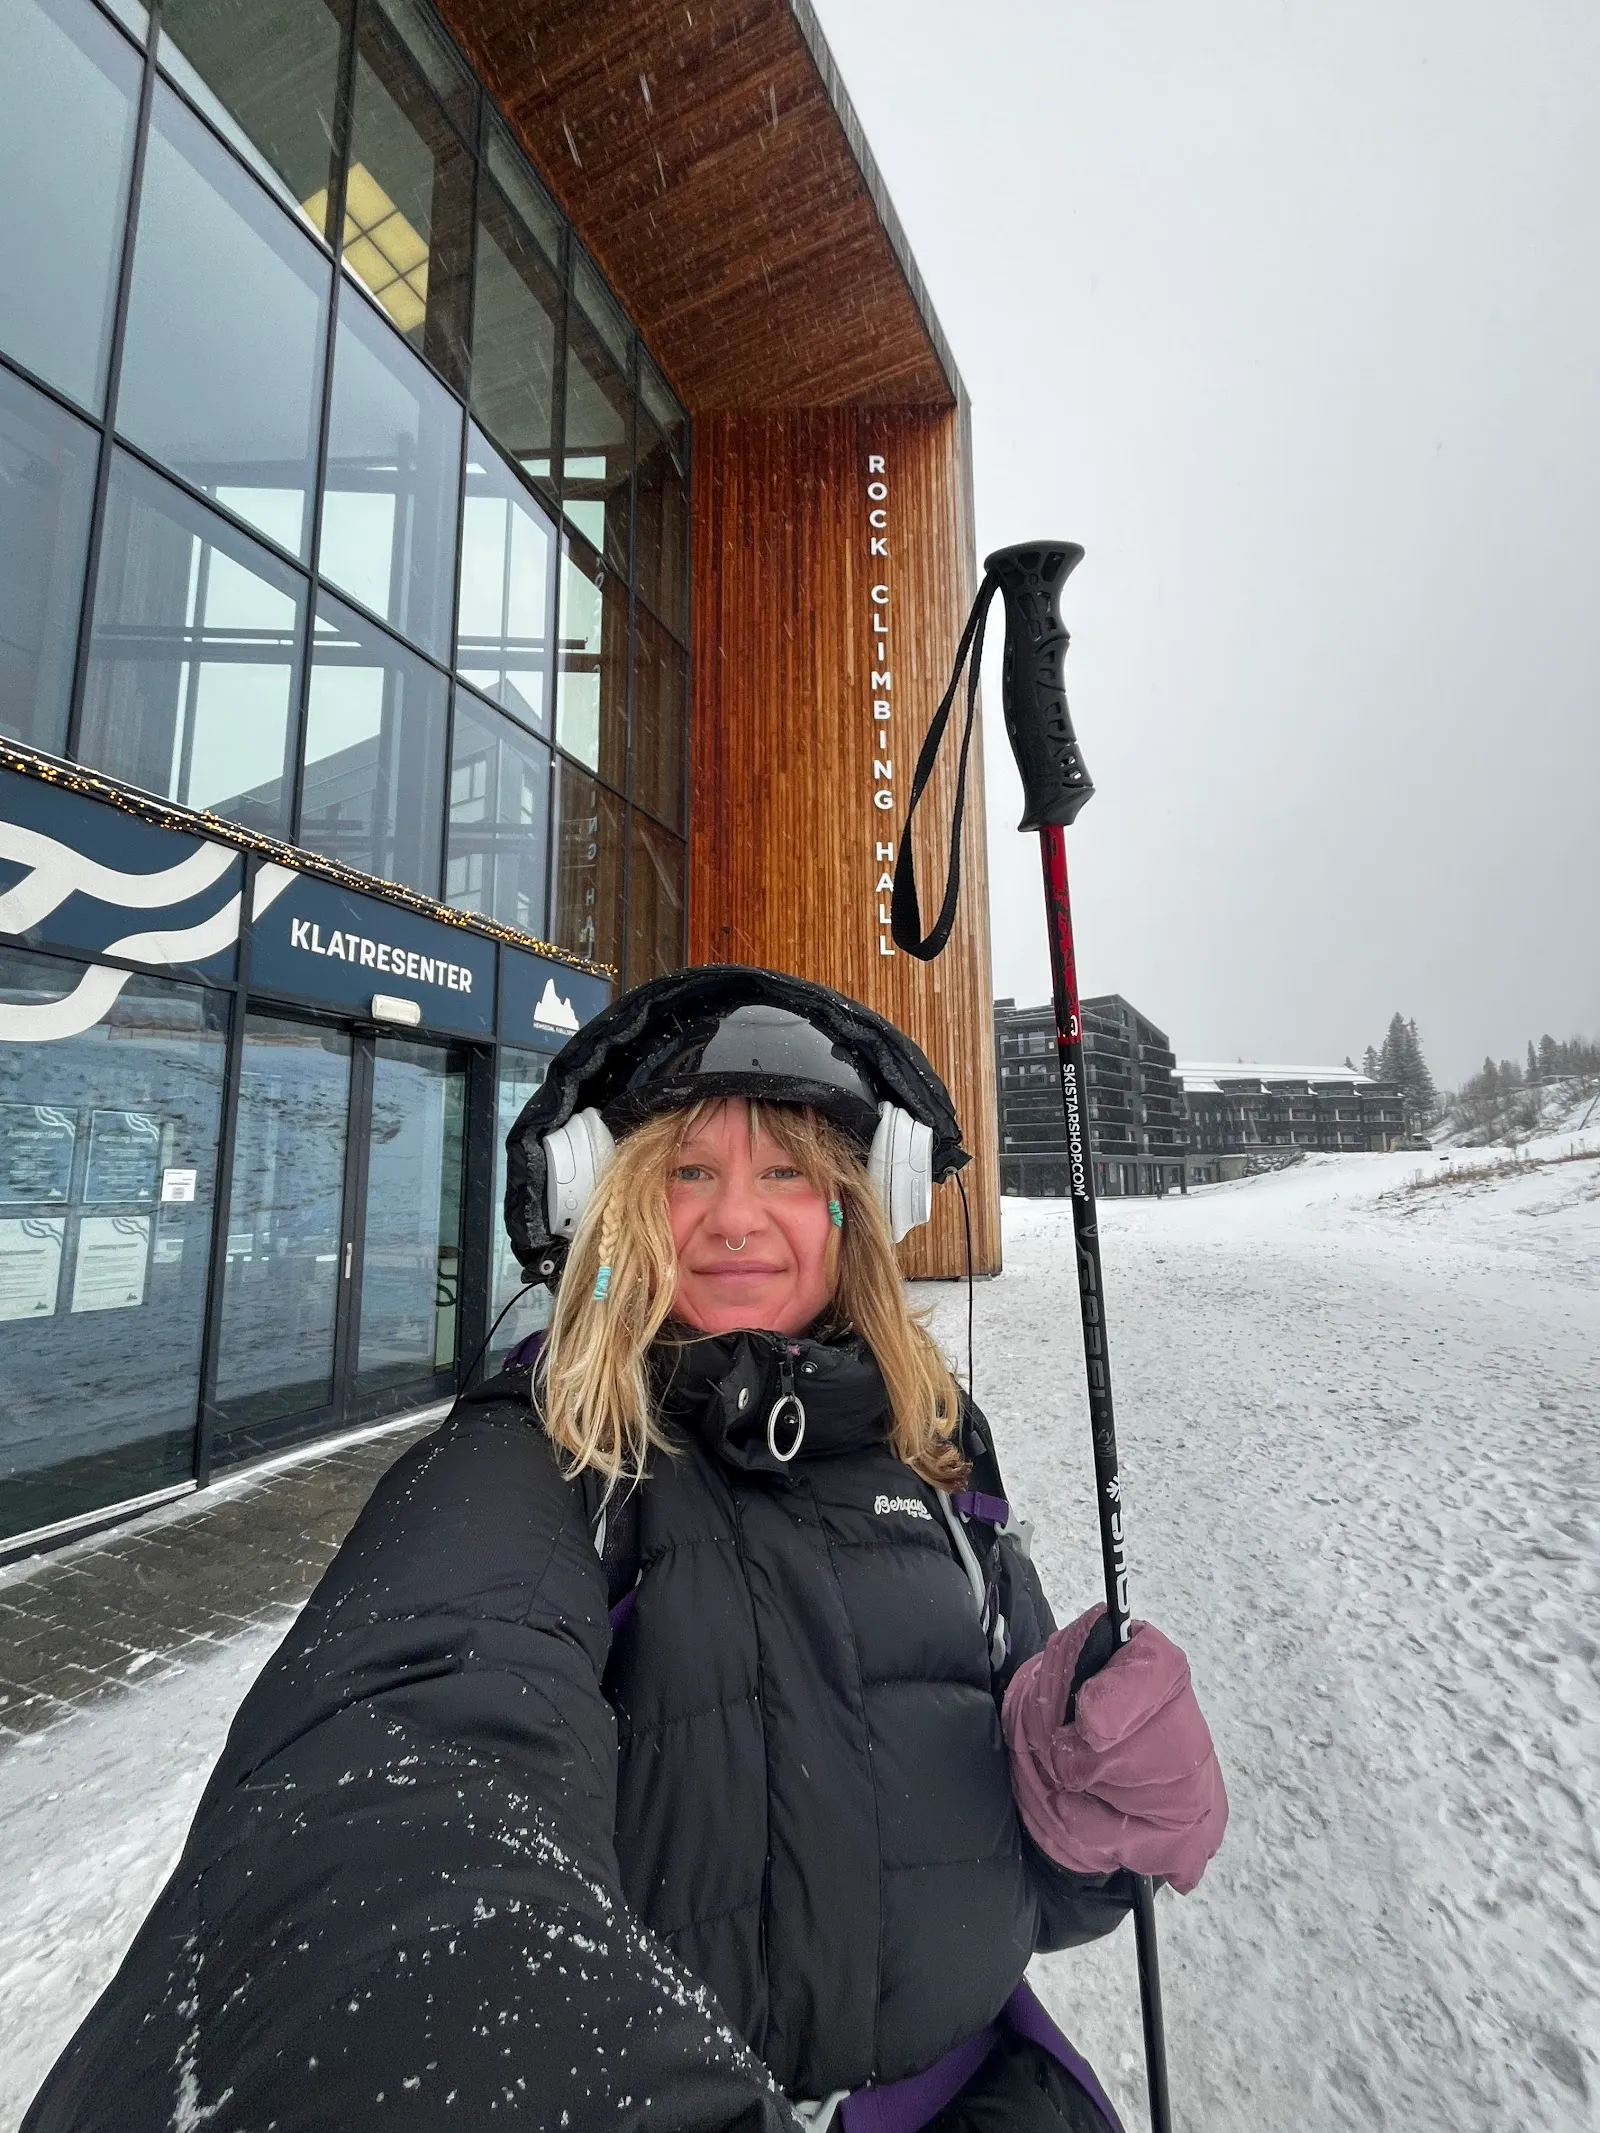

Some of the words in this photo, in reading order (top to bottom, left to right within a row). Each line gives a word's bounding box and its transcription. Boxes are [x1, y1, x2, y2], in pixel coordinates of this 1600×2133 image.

[868, 455, 889, 557] ROCK
[869, 584, 894, 810] CLIMBING
[290, 917, 473, 994] KLATRESENTER
[875, 842, 896, 957] HALL
[1062, 1063, 1086, 1197] SKISTARSHOP.COM
